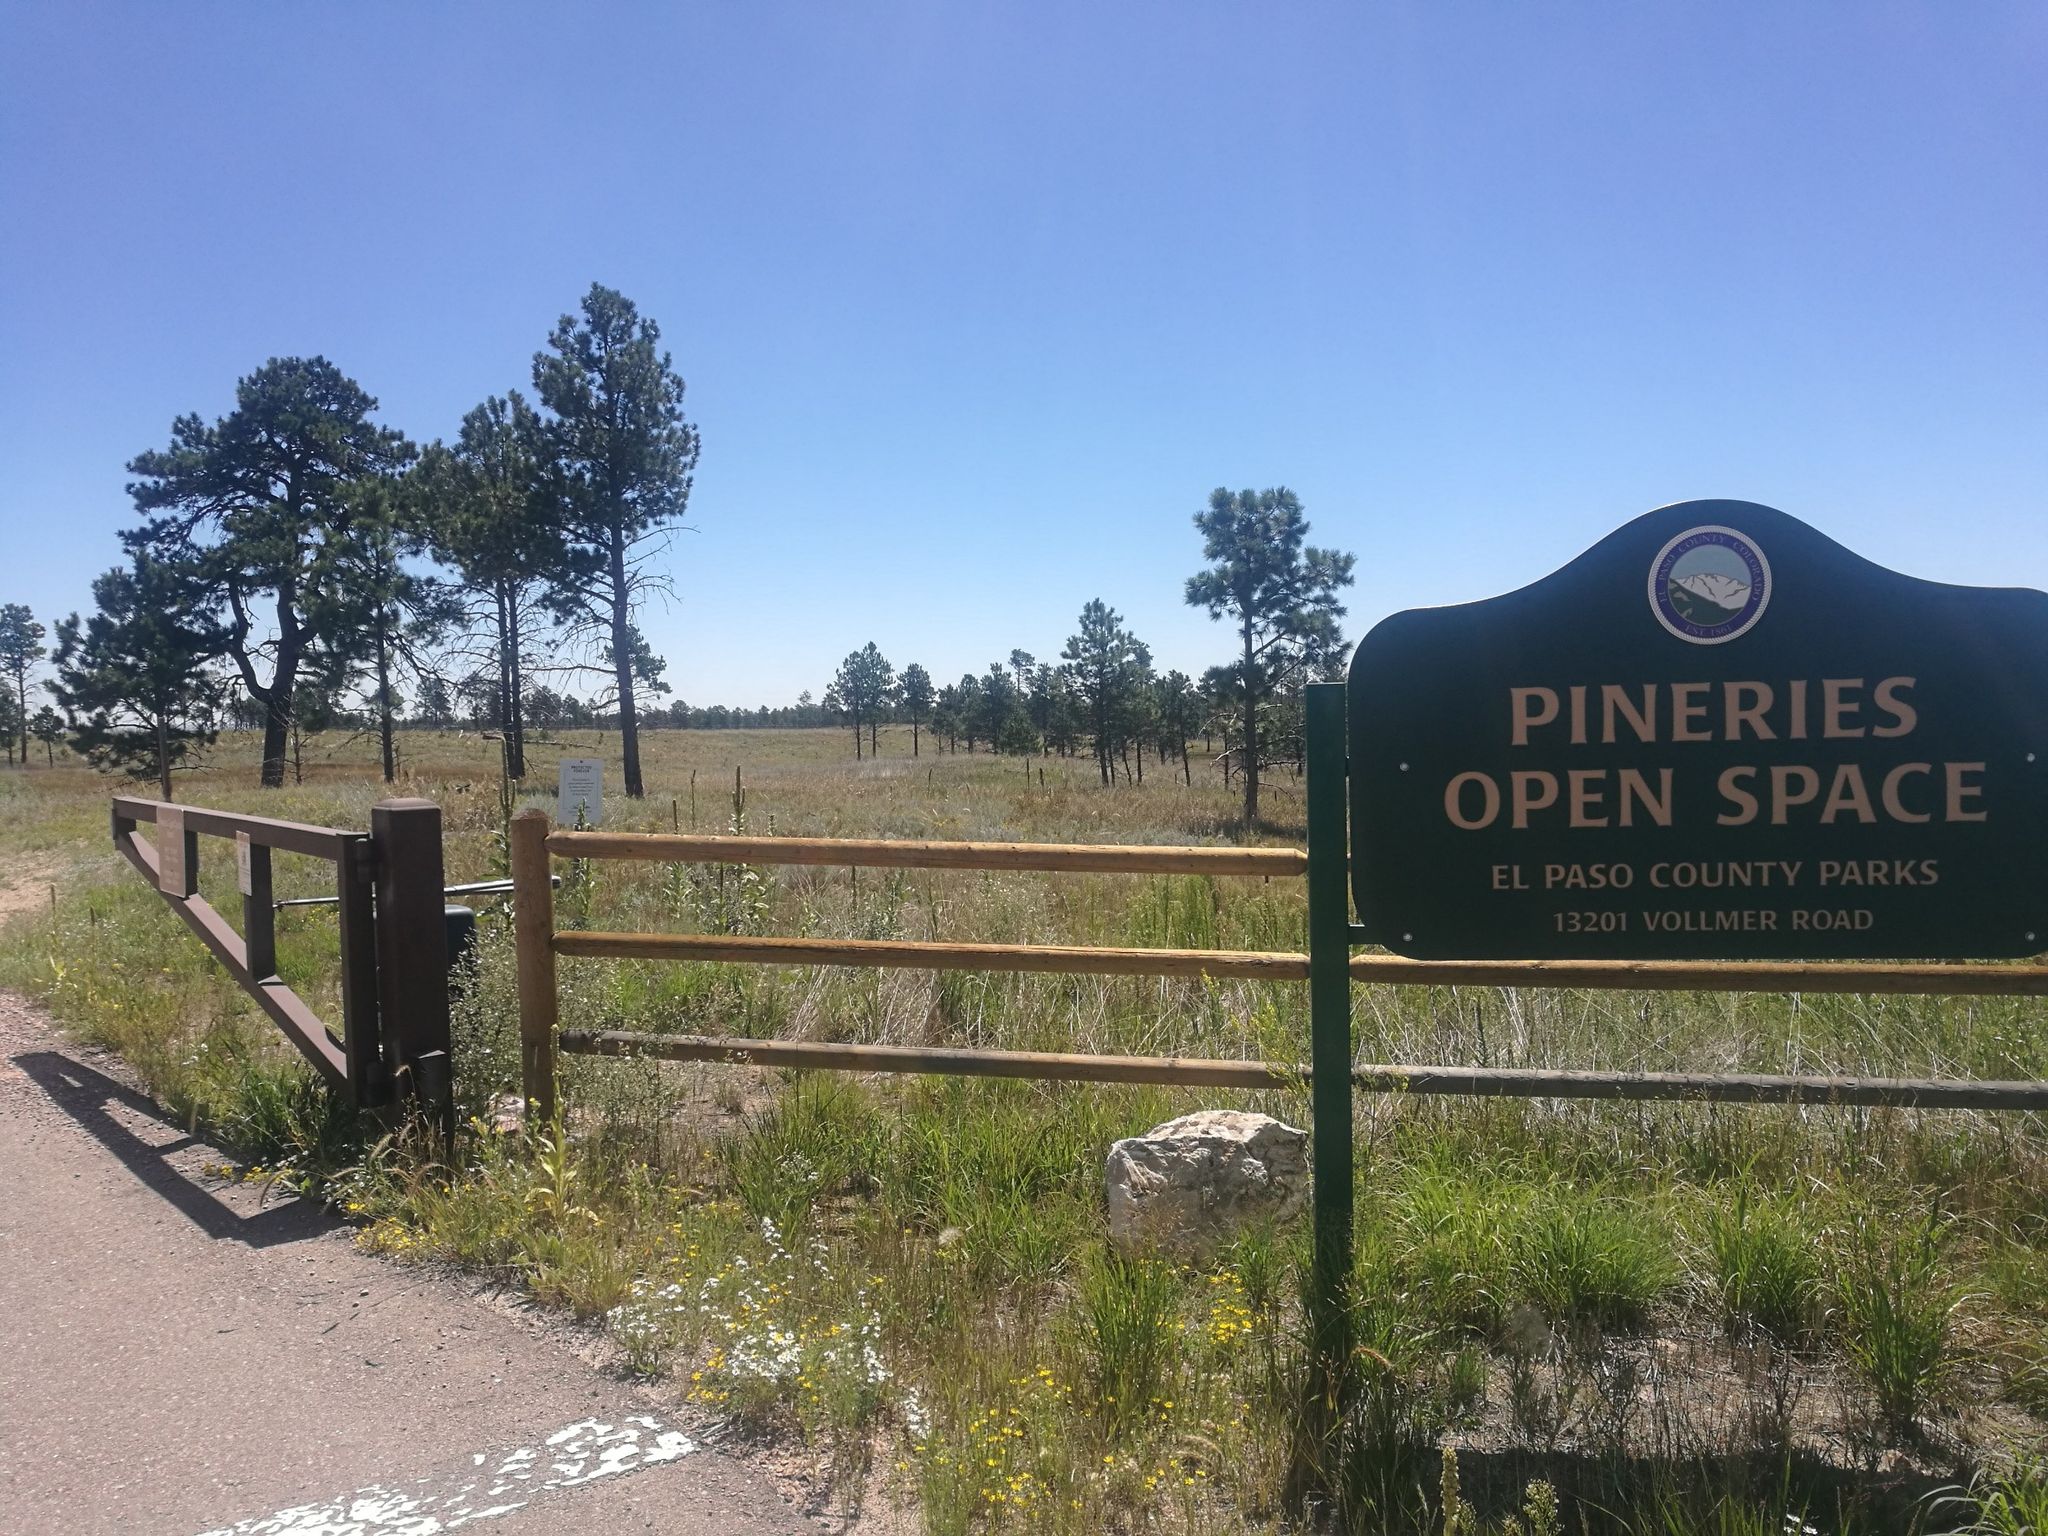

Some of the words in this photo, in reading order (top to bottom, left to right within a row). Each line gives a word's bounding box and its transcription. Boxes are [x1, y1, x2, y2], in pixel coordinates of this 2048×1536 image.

[1658, 554, 1674, 580] PASO
[1678, 534, 1725, 553] COUNTY
[1732, 541, 1762, 601] COLORADO
[1510, 676, 1918, 746] PINERIES
[1444, 768, 1673, 831] OPEN
[1716, 762, 1988, 826] SPACE
[1492, 864, 1530, 890] EL
[1545, 863, 1634, 889] PASO
[1649, 861, 1802, 888] COUNTY
[1820, 860, 1939, 886] PARKS
[1554, 911, 1628, 932] 13201
[1643, 910, 1778, 931] VOLLMER
[1792, 909, 1874, 930] ROAD
